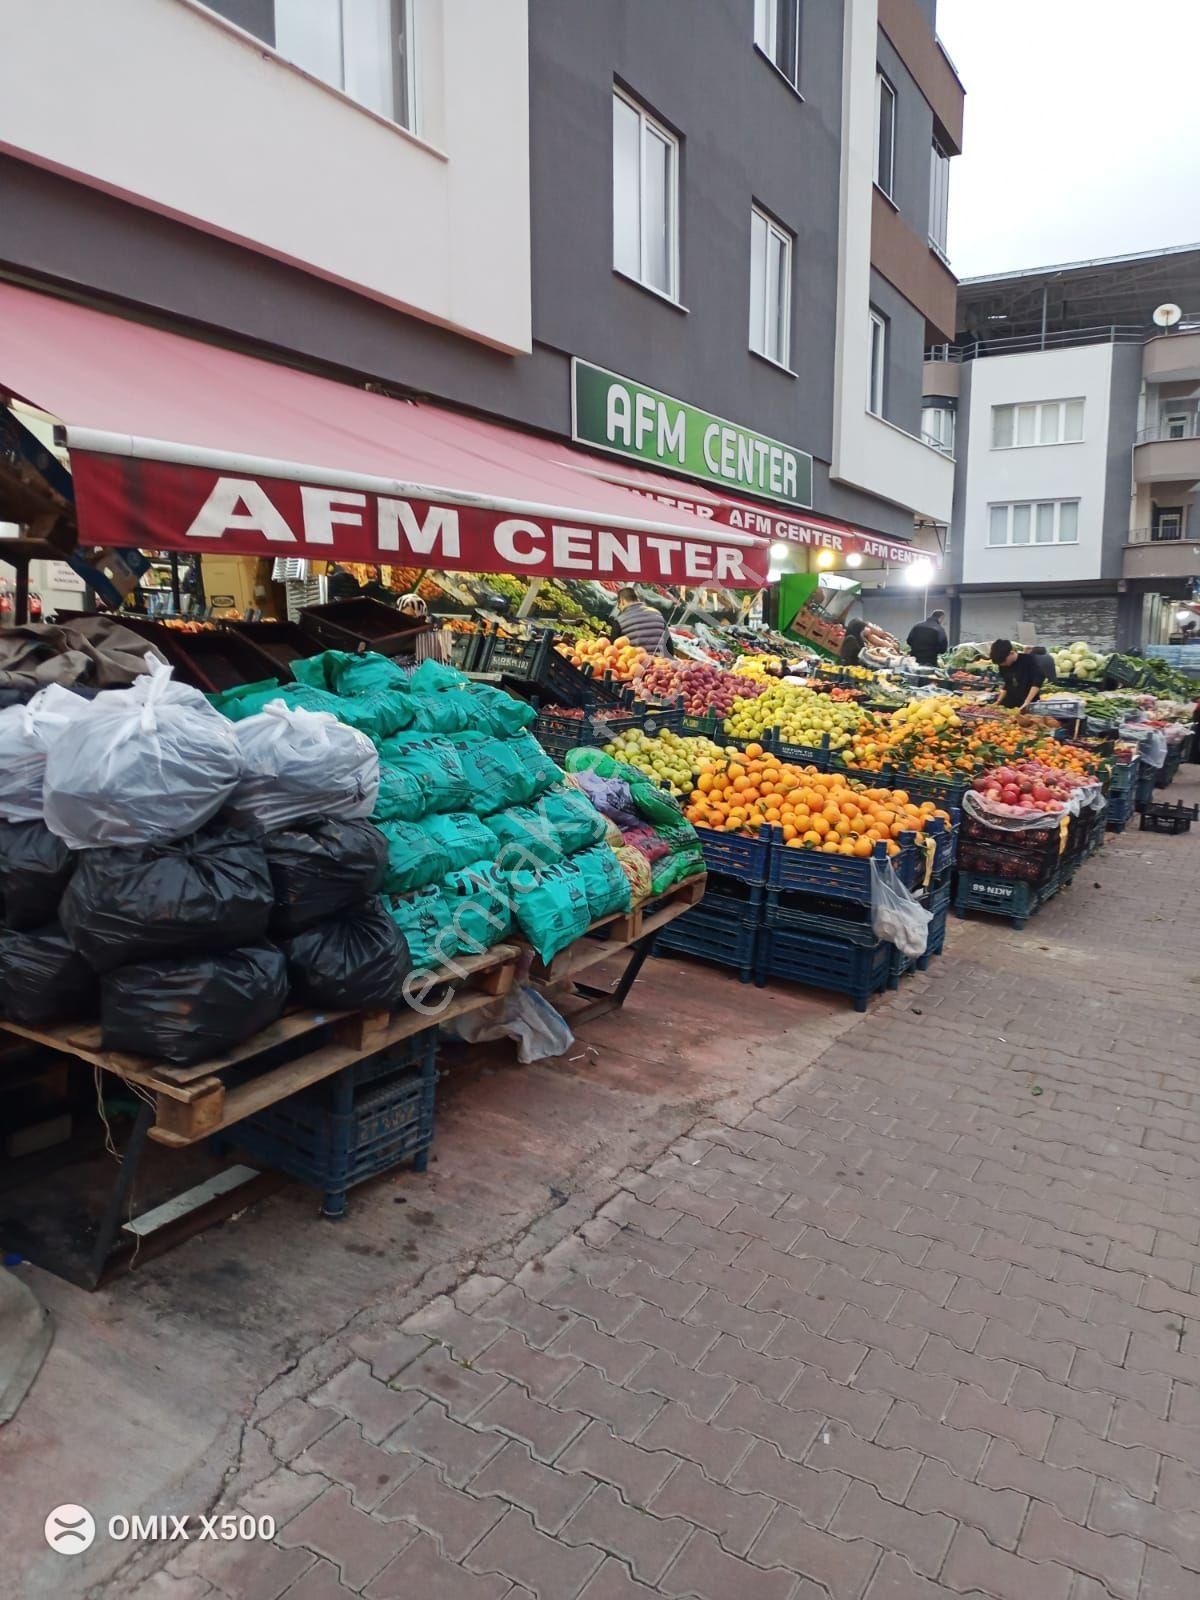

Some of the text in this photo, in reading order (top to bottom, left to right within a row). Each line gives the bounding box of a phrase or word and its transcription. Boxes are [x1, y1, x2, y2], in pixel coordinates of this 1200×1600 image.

[606, 384, 798, 498] AFM CENTER
[186, 477, 746, 582] AFM CENTER
[729, 508, 843, 551] AFM CENTER
[863, 541, 888, 558] AFM
